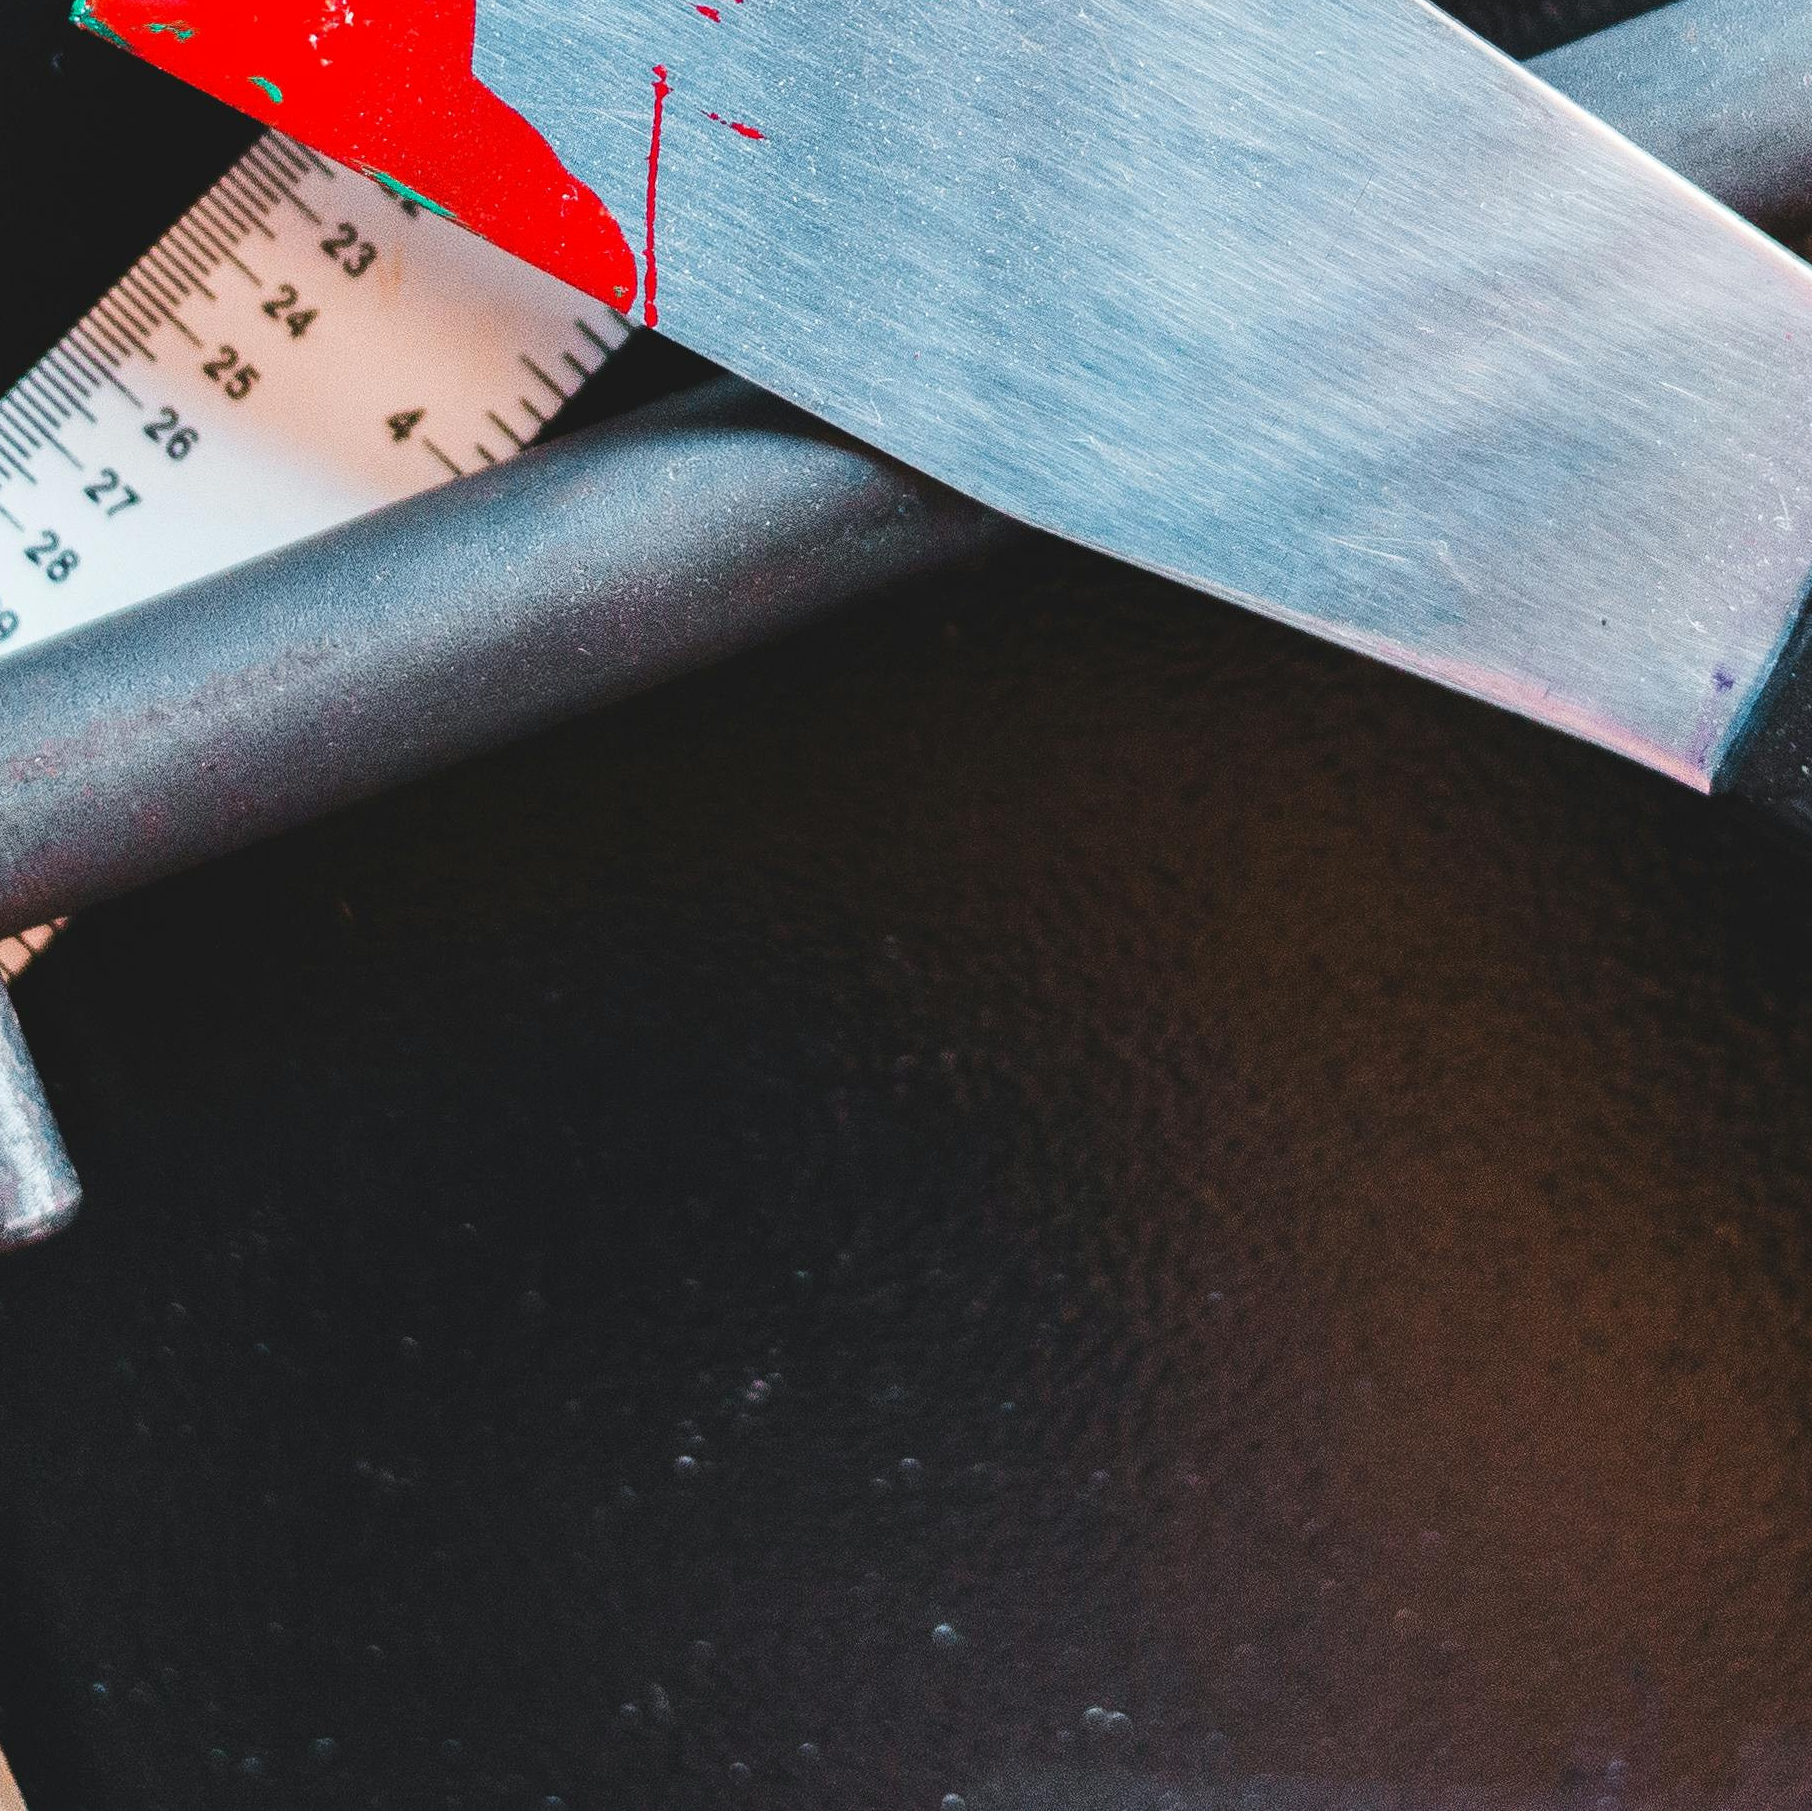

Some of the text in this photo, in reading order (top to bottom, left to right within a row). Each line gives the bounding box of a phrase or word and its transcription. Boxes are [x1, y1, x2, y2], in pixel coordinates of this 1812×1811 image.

[319, 222, 379, 279] 23
[262, 284, 319, 340] 24
[203, 344, 261, 402] 25
[144, 406, 199, 462] 26
[384, 408, 426, 443] 4
[84, 468, 142, 517] 27
[23, 529, 81, 584] 28
